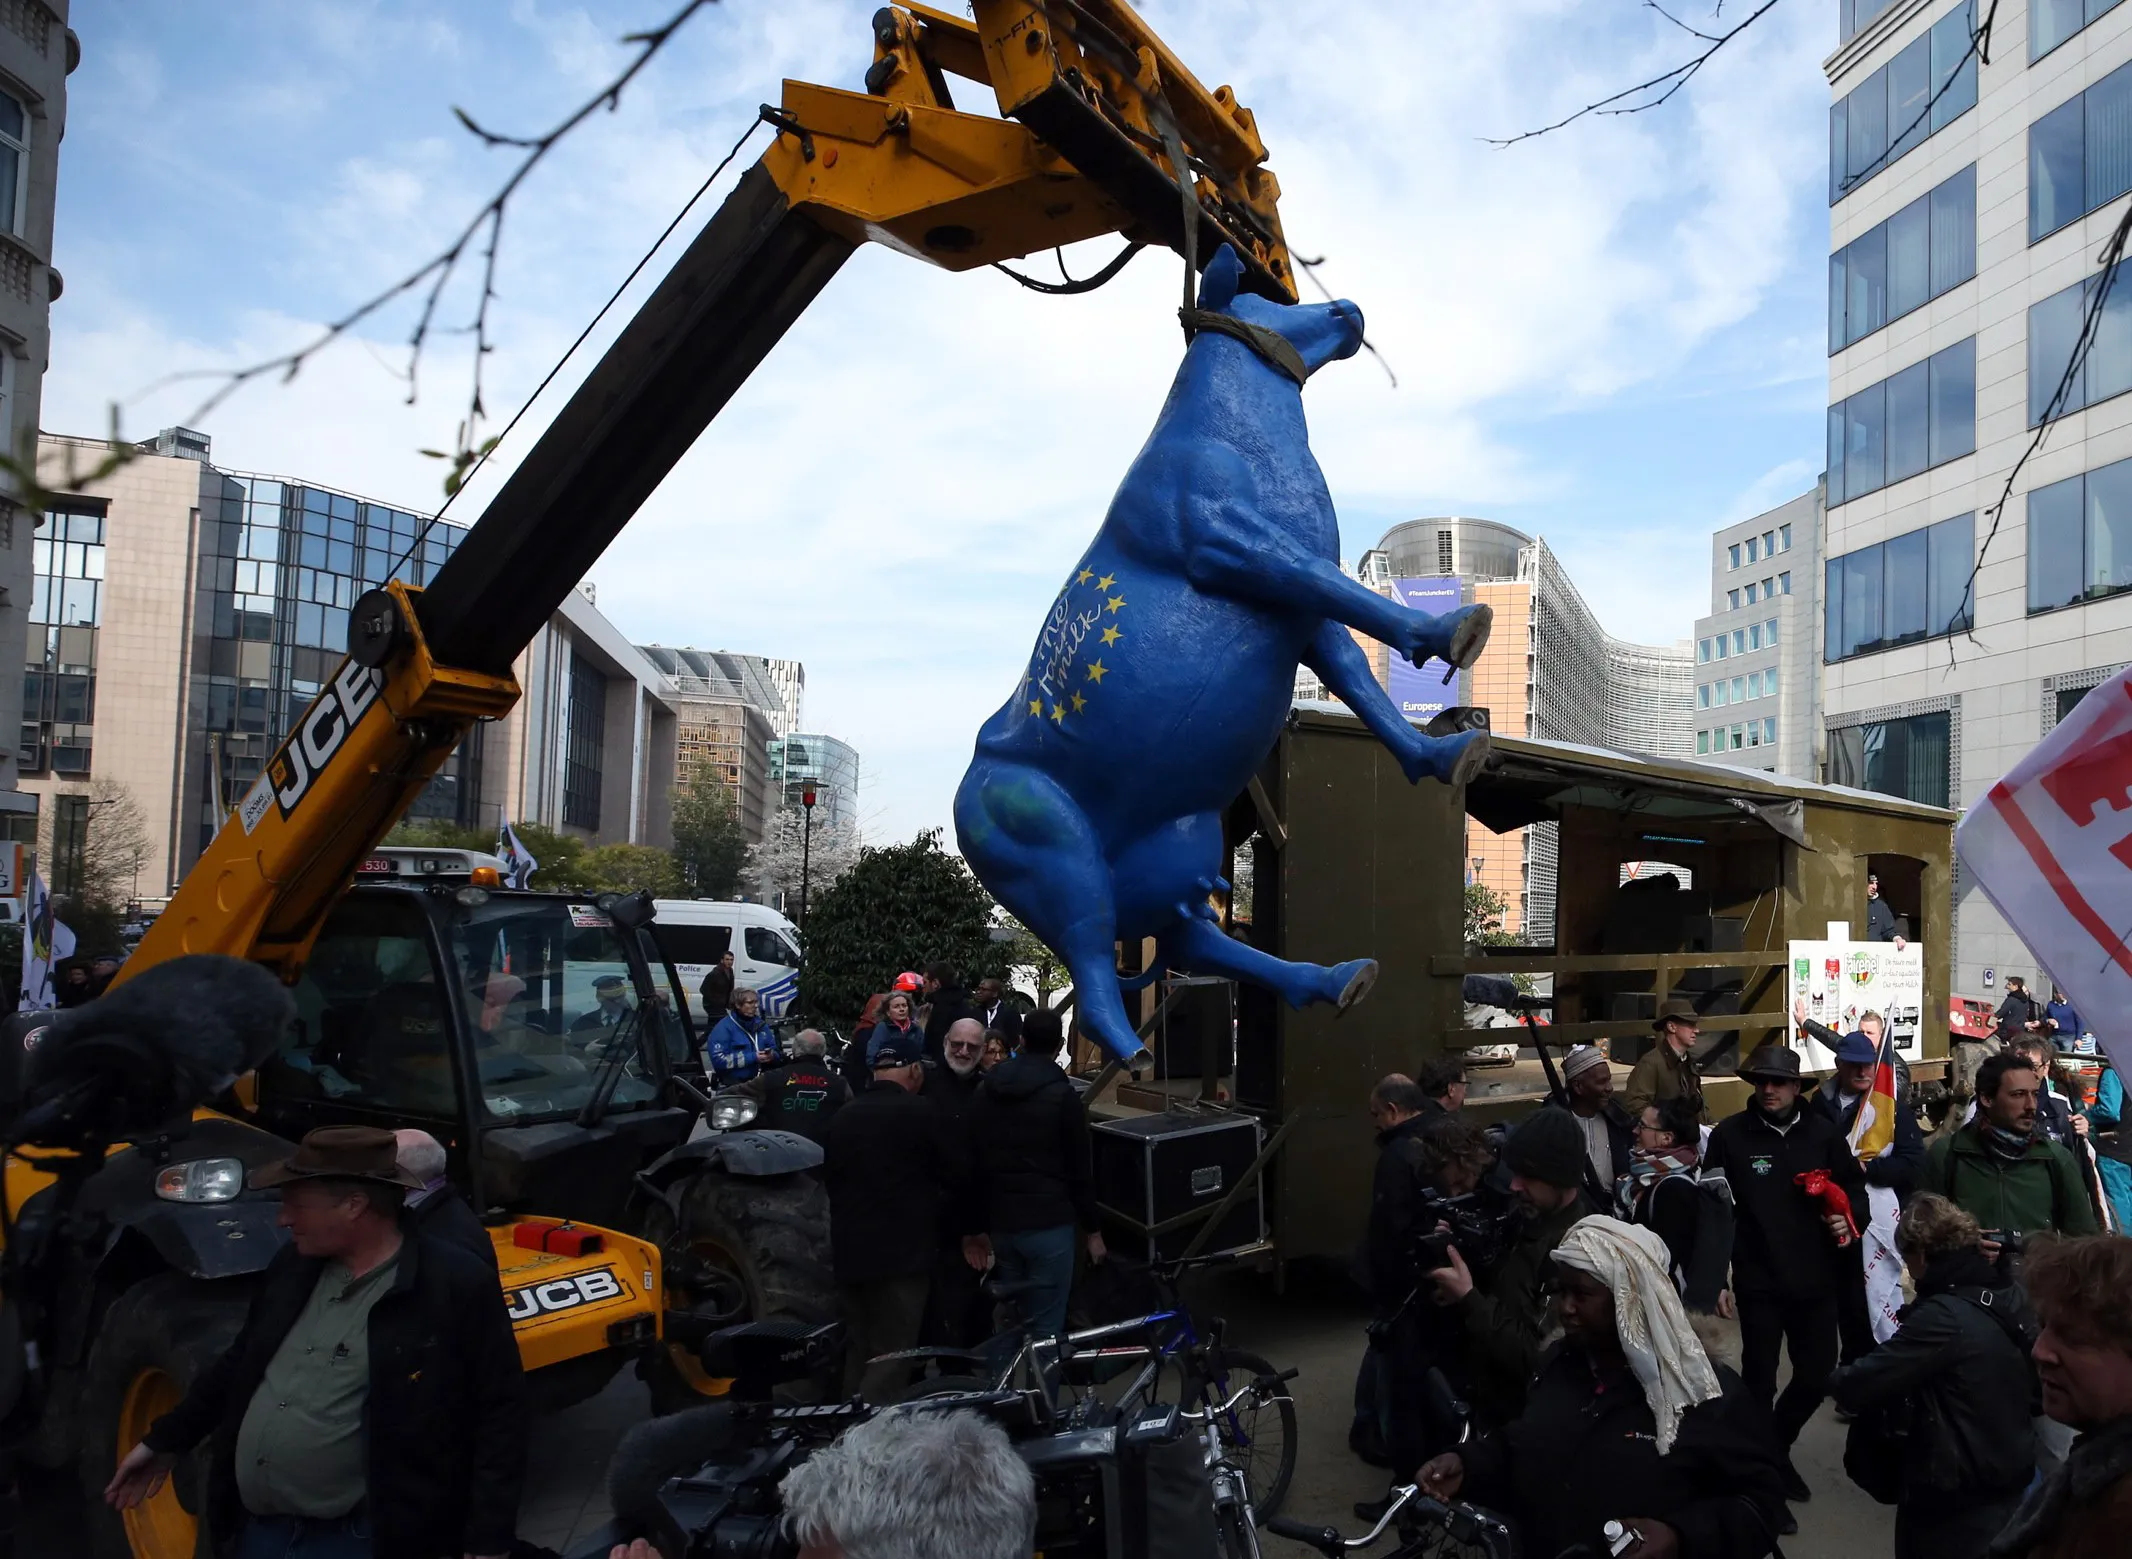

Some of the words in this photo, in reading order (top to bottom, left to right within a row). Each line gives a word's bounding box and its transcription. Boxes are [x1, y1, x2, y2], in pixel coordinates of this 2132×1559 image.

[1408, 589, 1455, 597] #TeamJunckerEU
[1402, 702, 1443, 714] Europese
[364, 860, 389, 871] 530
[678, 964, 701, 973] Police
[1844, 952, 1880, 975] fairebel
[508, 1271, 620, 1320] JCB
